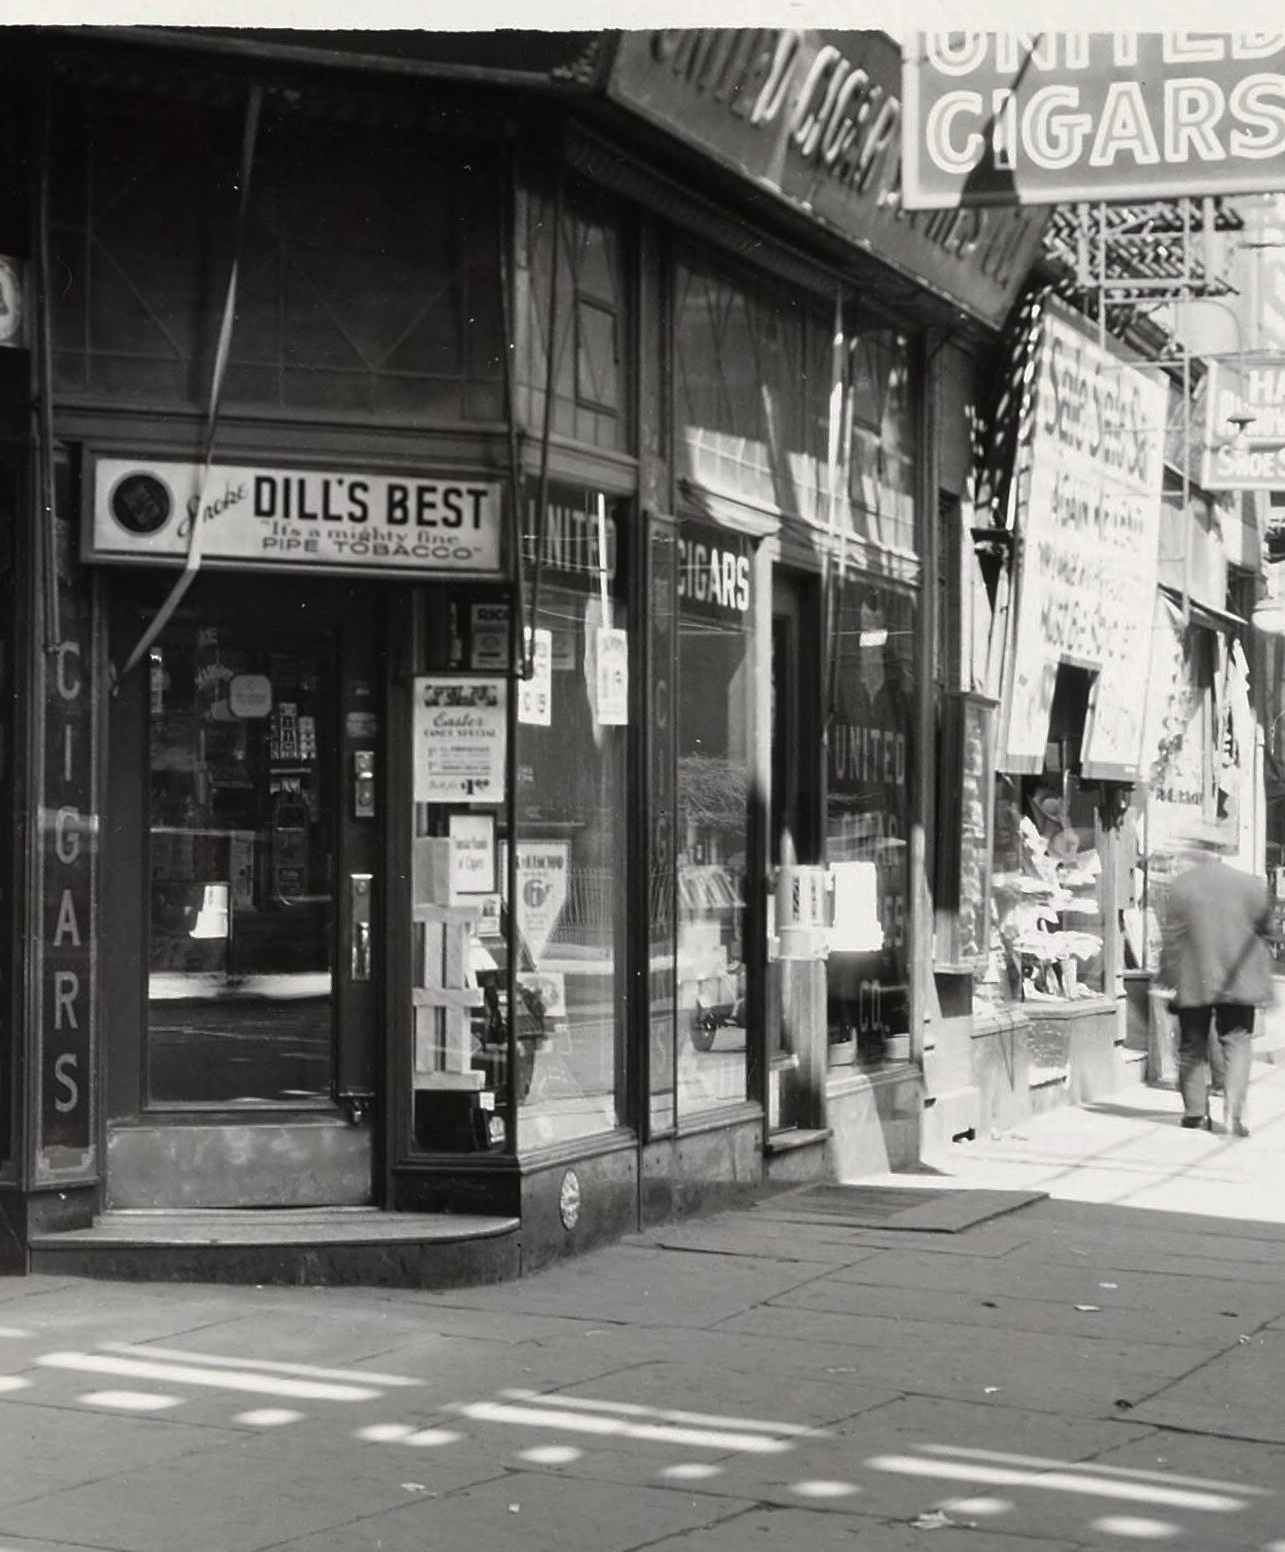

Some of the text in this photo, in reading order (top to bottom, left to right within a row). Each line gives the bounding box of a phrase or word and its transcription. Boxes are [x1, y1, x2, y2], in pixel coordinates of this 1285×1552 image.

[254, 475, 370, 524] DILL'S
[387, 482, 488, 529] BEST
[262, 537, 319, 553] PIPE
[309, 528, 321, 539] a
[327, 524, 408, 544] mighty
[416, 529, 459, 546] fine
[677, 538, 750, 611] CIGARS
[835, 725, 905, 786] UNITED
[52, 640, 82, 1113] CIGARS
